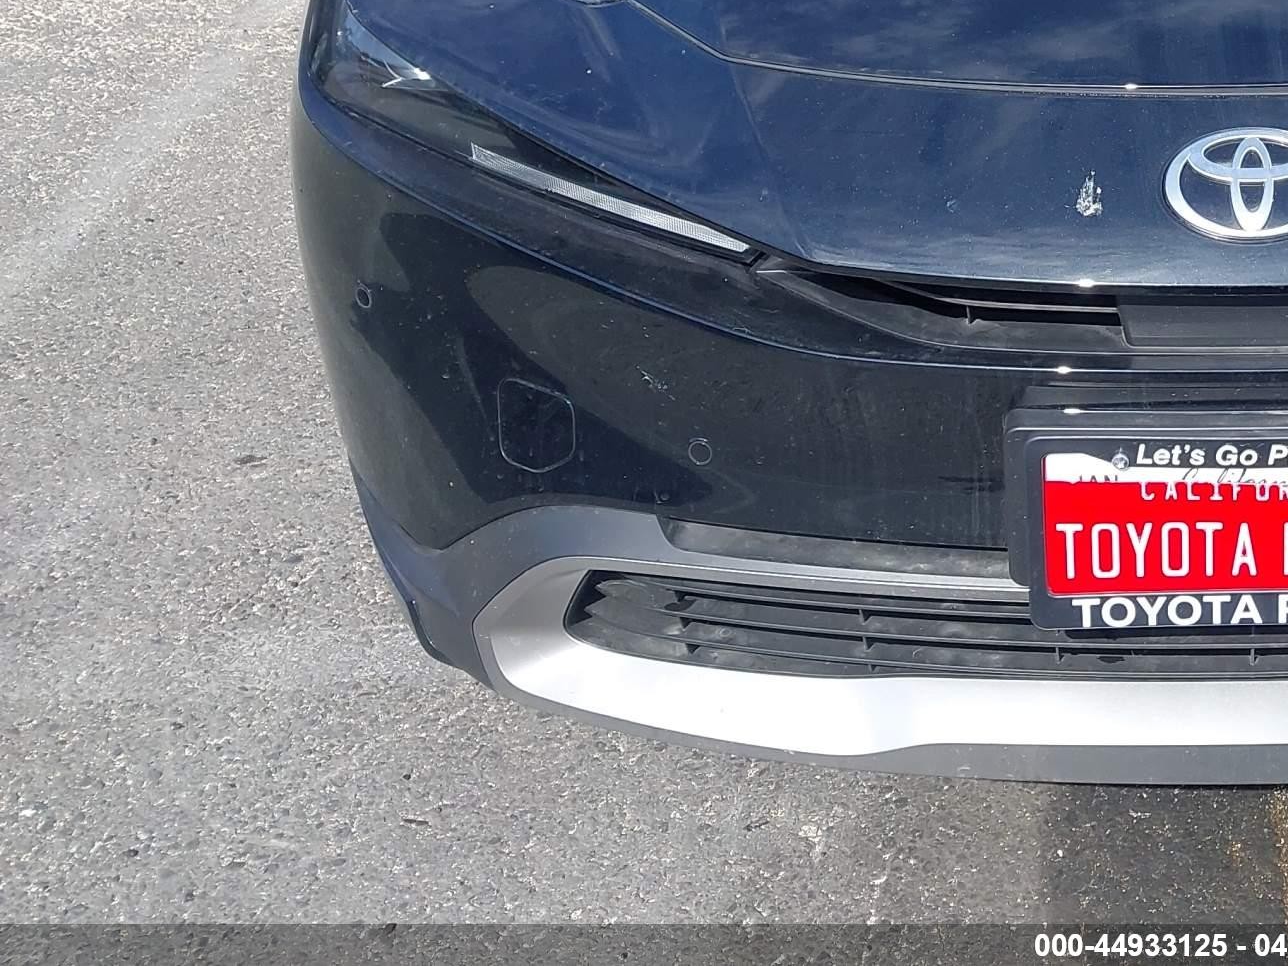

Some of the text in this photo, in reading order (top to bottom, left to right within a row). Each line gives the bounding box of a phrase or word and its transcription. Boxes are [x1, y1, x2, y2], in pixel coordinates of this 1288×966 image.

[1136, 444, 1206, 466] Let's
[1215, 444, 1258, 466] Go
[1055, 521, 1257, 579] TOYOTA
[1071, 594, 1263, 628] TOYOTA
